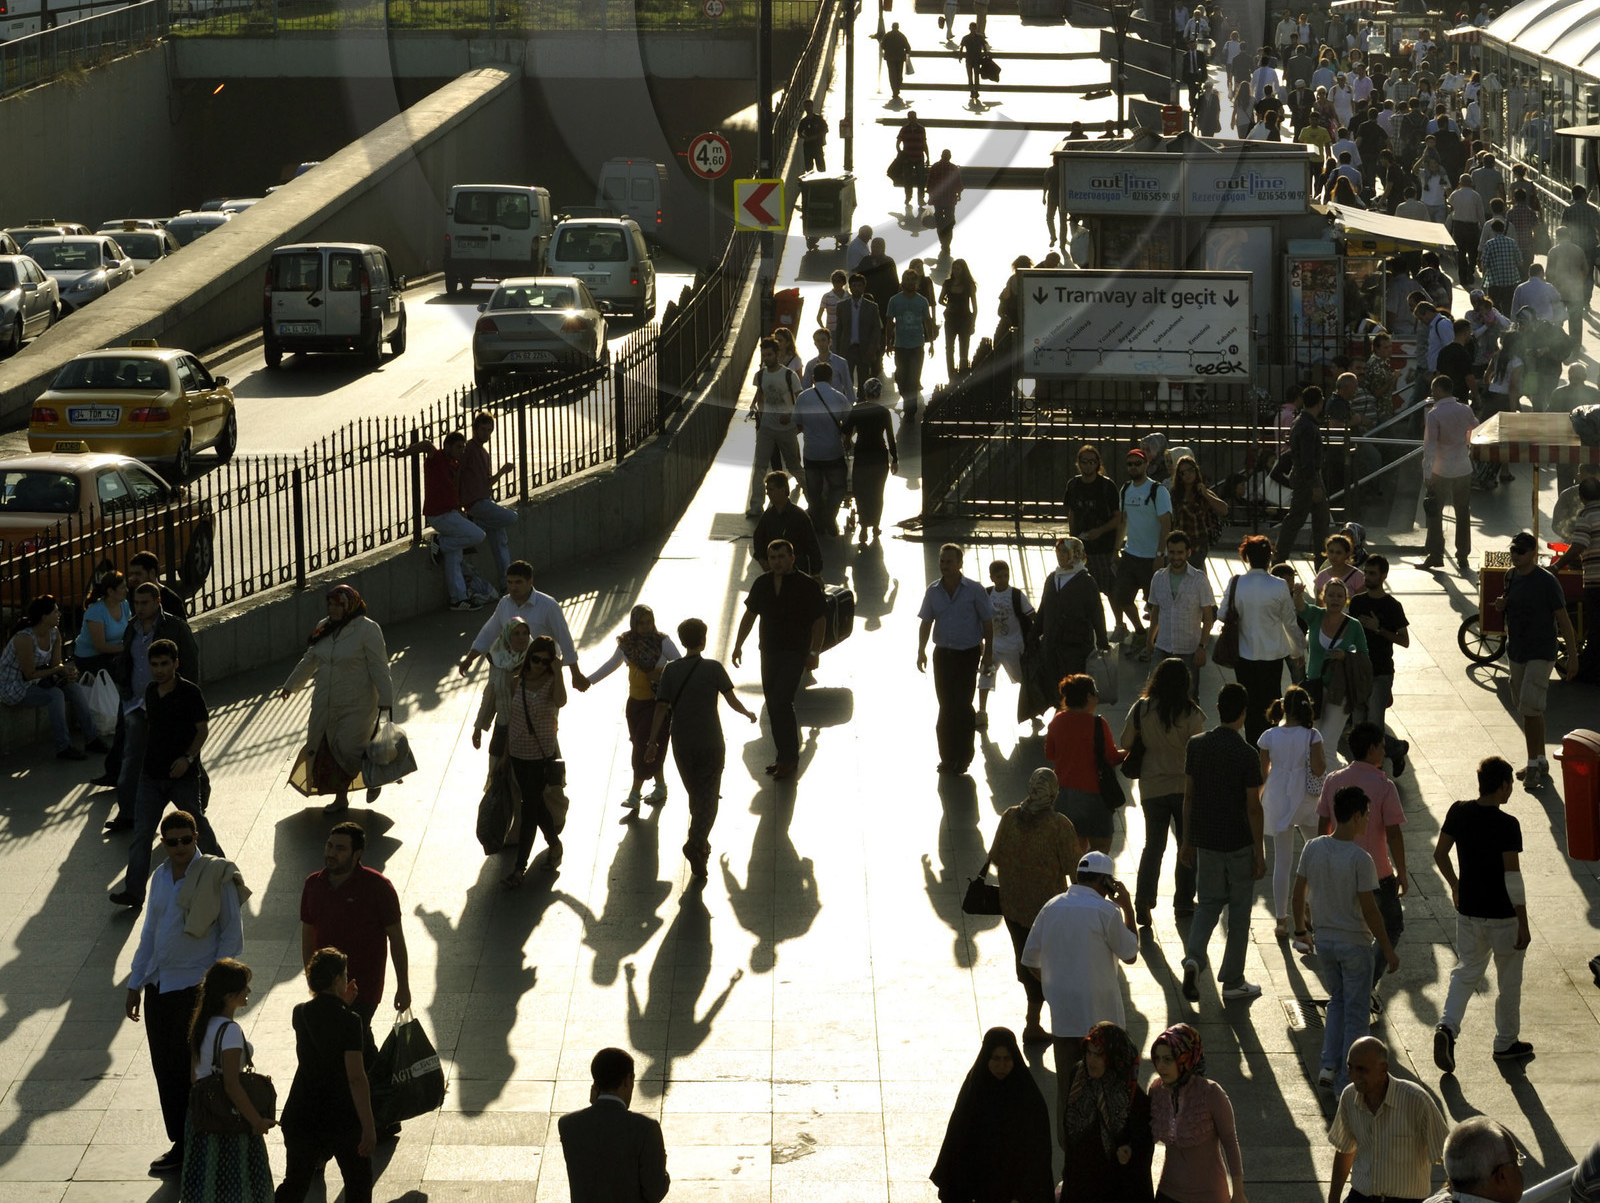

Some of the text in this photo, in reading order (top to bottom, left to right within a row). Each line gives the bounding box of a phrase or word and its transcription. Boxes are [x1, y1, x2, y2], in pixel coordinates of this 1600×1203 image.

[1068, 190, 1121, 202] Rezervasyon
[1132, 192, 1149, 201] 0216
[1192, 192, 1246, 203] Rezervasyon
[1258, 191, 1275, 200] 0216
[1055, 287, 1217, 310] Tramvay alt geçit
[76, 410, 84, 418] 34
[107, 410, 115, 418] 42
